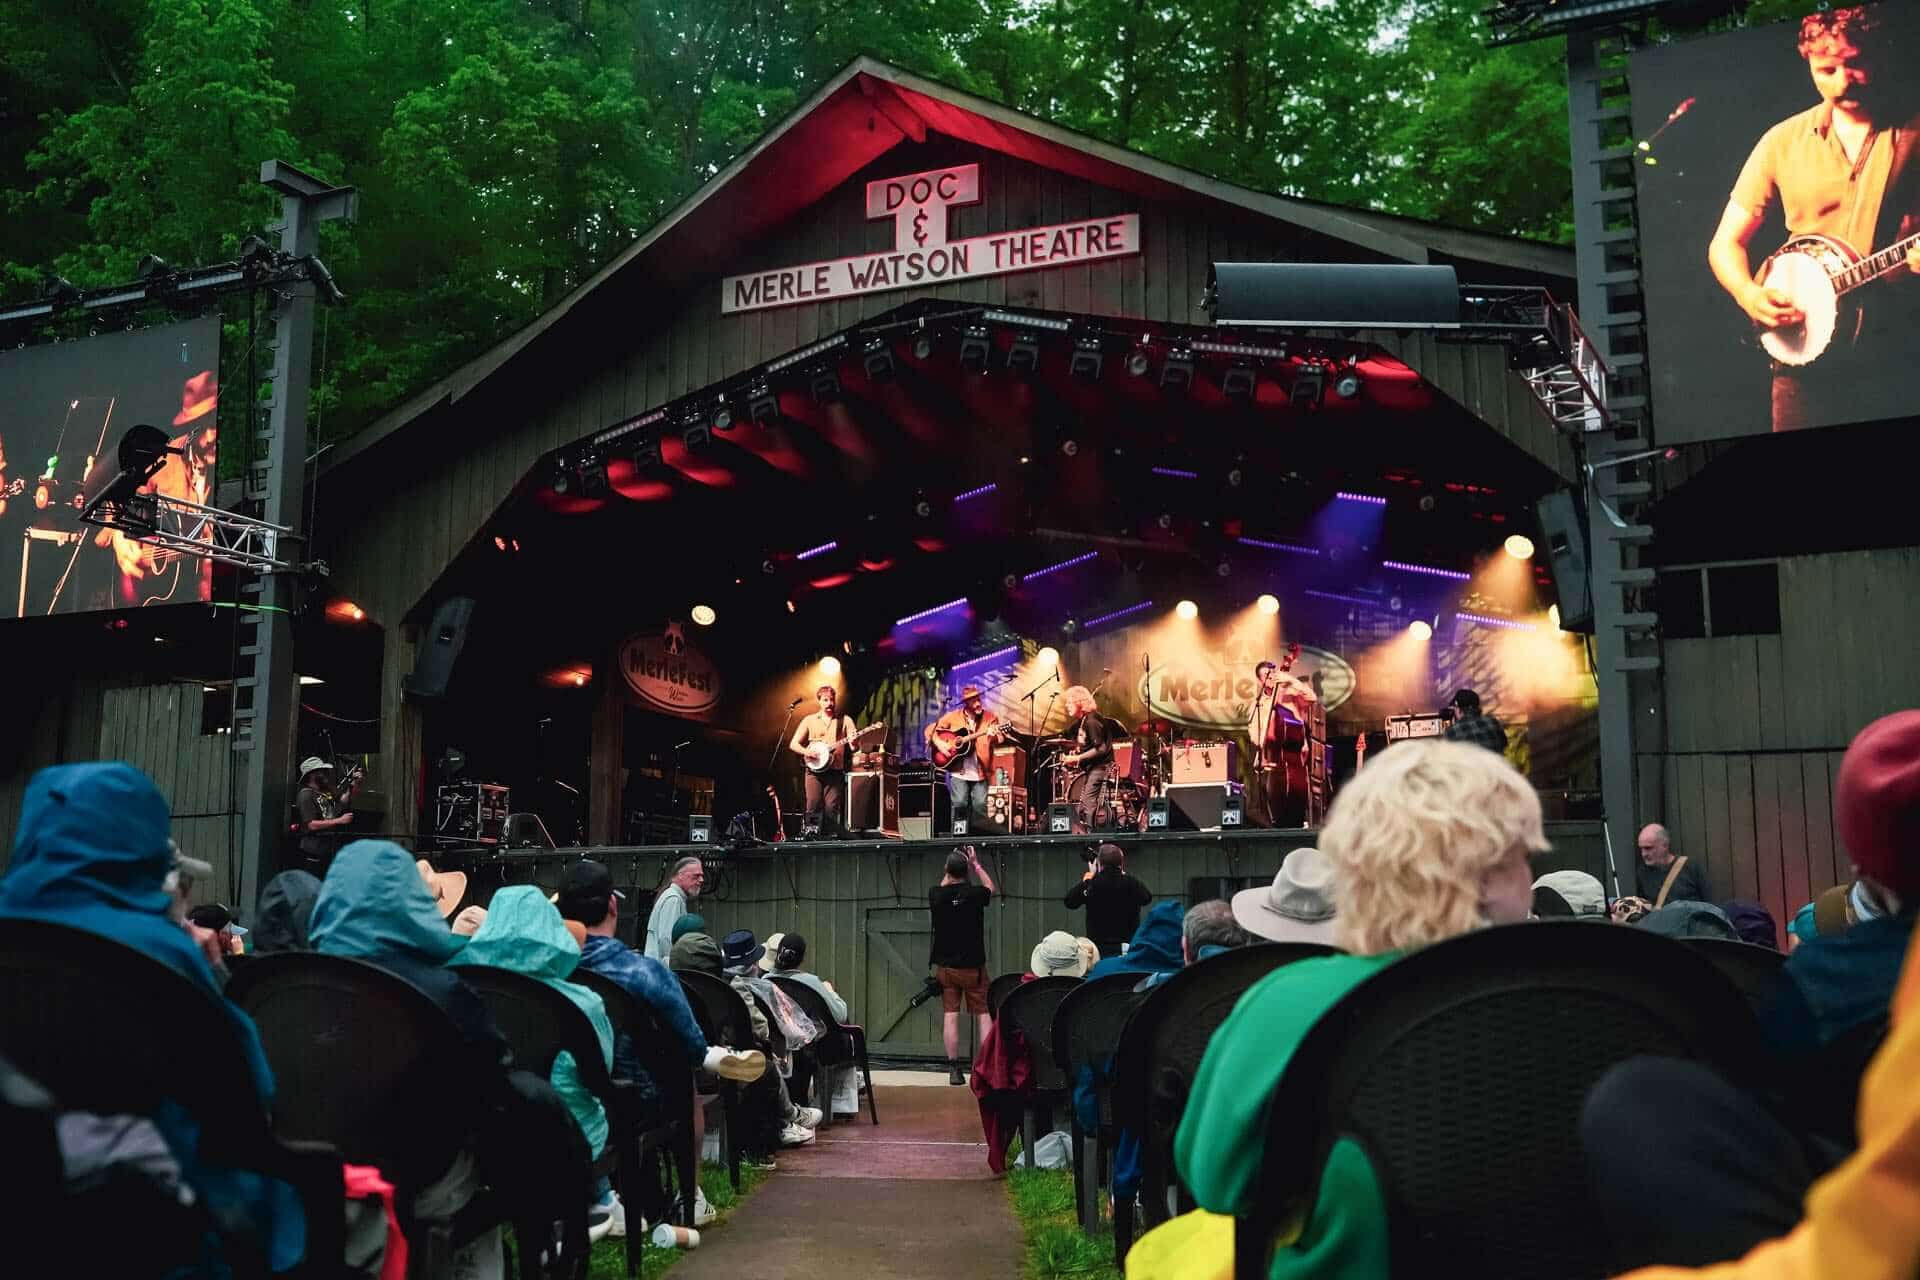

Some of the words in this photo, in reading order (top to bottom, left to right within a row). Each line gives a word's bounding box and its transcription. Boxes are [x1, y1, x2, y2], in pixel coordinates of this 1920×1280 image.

[886, 173, 958, 210] DOC
[912, 208, 929, 248] &
[734, 265, 831, 307] MERLE
[848, 244, 969, 290] WATSON
[989, 220, 1125, 267] THEATRE
[1159, 671, 1325, 702] Merlet
